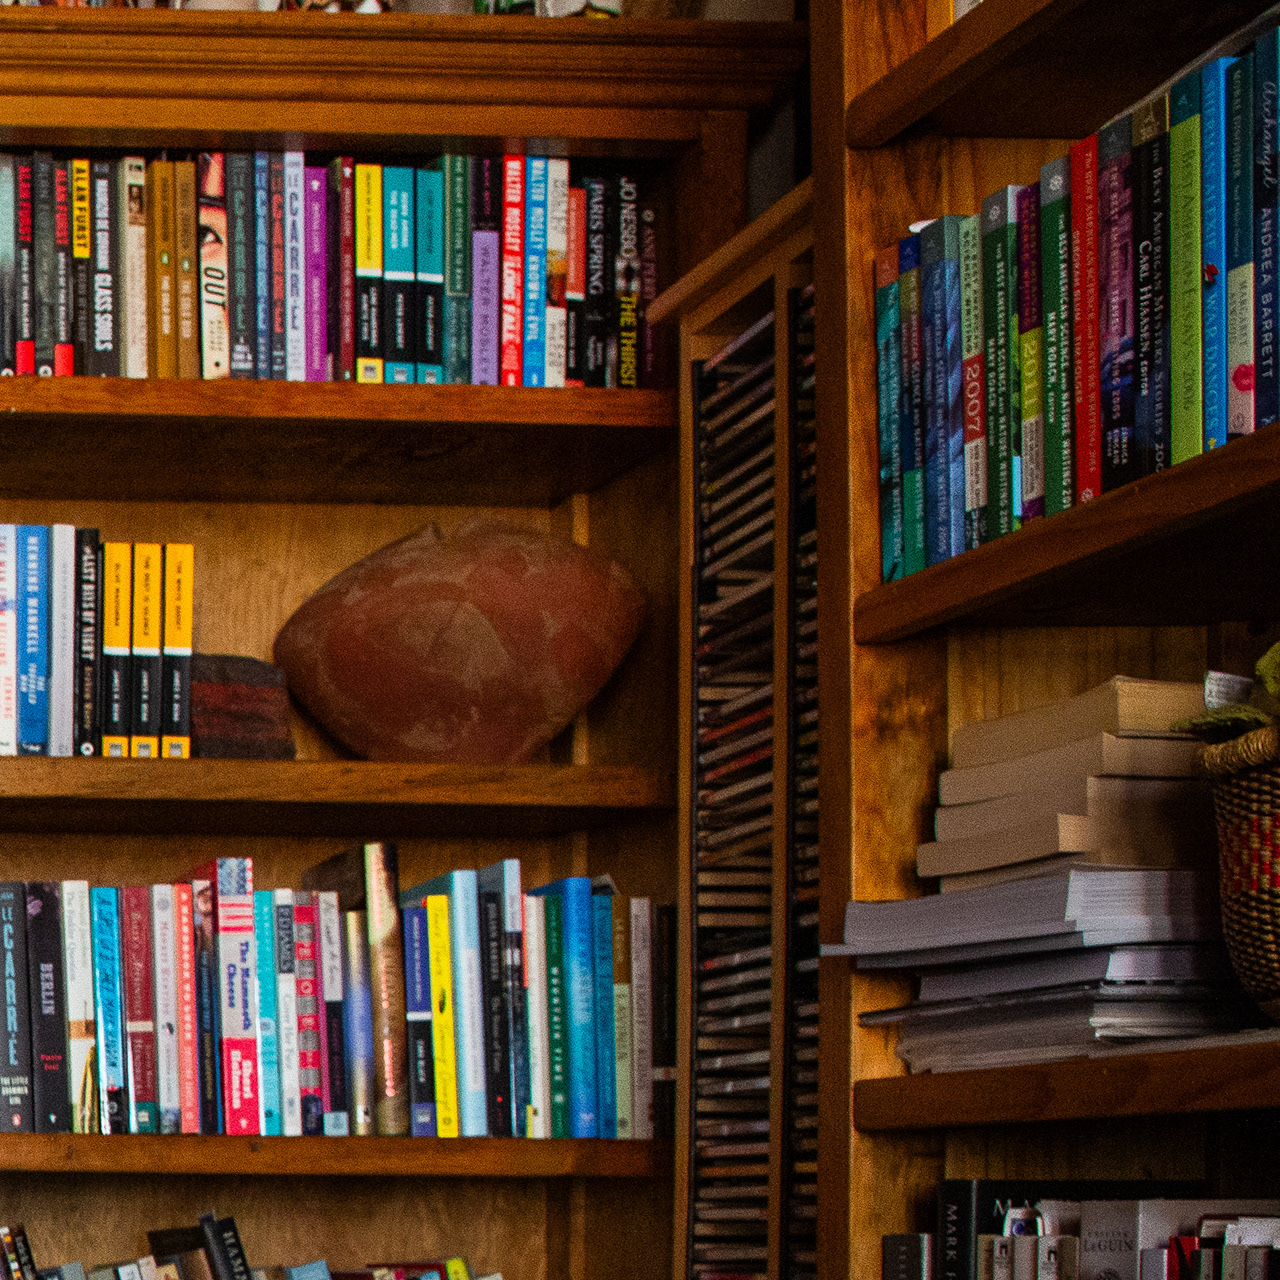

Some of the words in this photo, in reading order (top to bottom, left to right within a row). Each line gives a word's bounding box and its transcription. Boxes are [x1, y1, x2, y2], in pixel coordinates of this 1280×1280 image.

[76, 167, 89, 203] ALAN
[505, 159, 521, 203] WALTER
[531, 159, 545, 202] WALTER
[619, 178, 638, 201] JO
[1151, 166, 1164, 199] BEST
[76, 206, 89, 250] FURST
[505, 206, 521, 252] MOSLEY
[531, 207, 545, 251] MOSLEY
[588, 182, 605, 230] PARIS
[588, 233, 605, 295] SPRING
[1058, 232, 1069, 264] BEST
[1138, 239, 1153, 282] CARL
[1151, 203, 1164, 289] AMERICAN
[1259, 206, 1272, 285] ANDREA
[94, 273, 112, 313] GLASS
[204, 267, 225, 310] OUT
[481, 246, 493, 307] WALTER
[996, 260, 1006, 285] BEST
[1058, 266, 1070, 319] AMERICAN
[94, 313, 113, 352] SOULS
[619, 295, 638, 326] THE
[997, 286, 1007, 344] AMERICAN
[1046, 312, 1057, 345] MARY
[1152, 295, 1165, 365] MYSTERY
[1205, 292, 1217, 338] WAR
[1260, 290, 1273, 379] BARRETT
[482, 313, 493, 375] MOSLEY
[619, 330, 638, 388] THIRST
[987, 337, 997, 366] MARY
[1059, 321, 1070, 370] SCIENCE
[997, 346, 1007, 393] SCIENCE
[1021, 341, 1038, 401] 2011
[1205, 346, 1217, 429] DANCES
[965, 362, 981, 433] 2007
[1153, 371, 1166, 436] STORIES
[27, 536, 39, 593] HENNING
[27, 597, 39, 654] MANKELL
[39, 962, 55, 1016] BERLIN
[225, 963, 237, 1009] Cheese
[239, 967, 253, 1031] Mammoth
[229, 1049, 243, 1110] Holman
[944, 1203, 959, 1261] MARK
